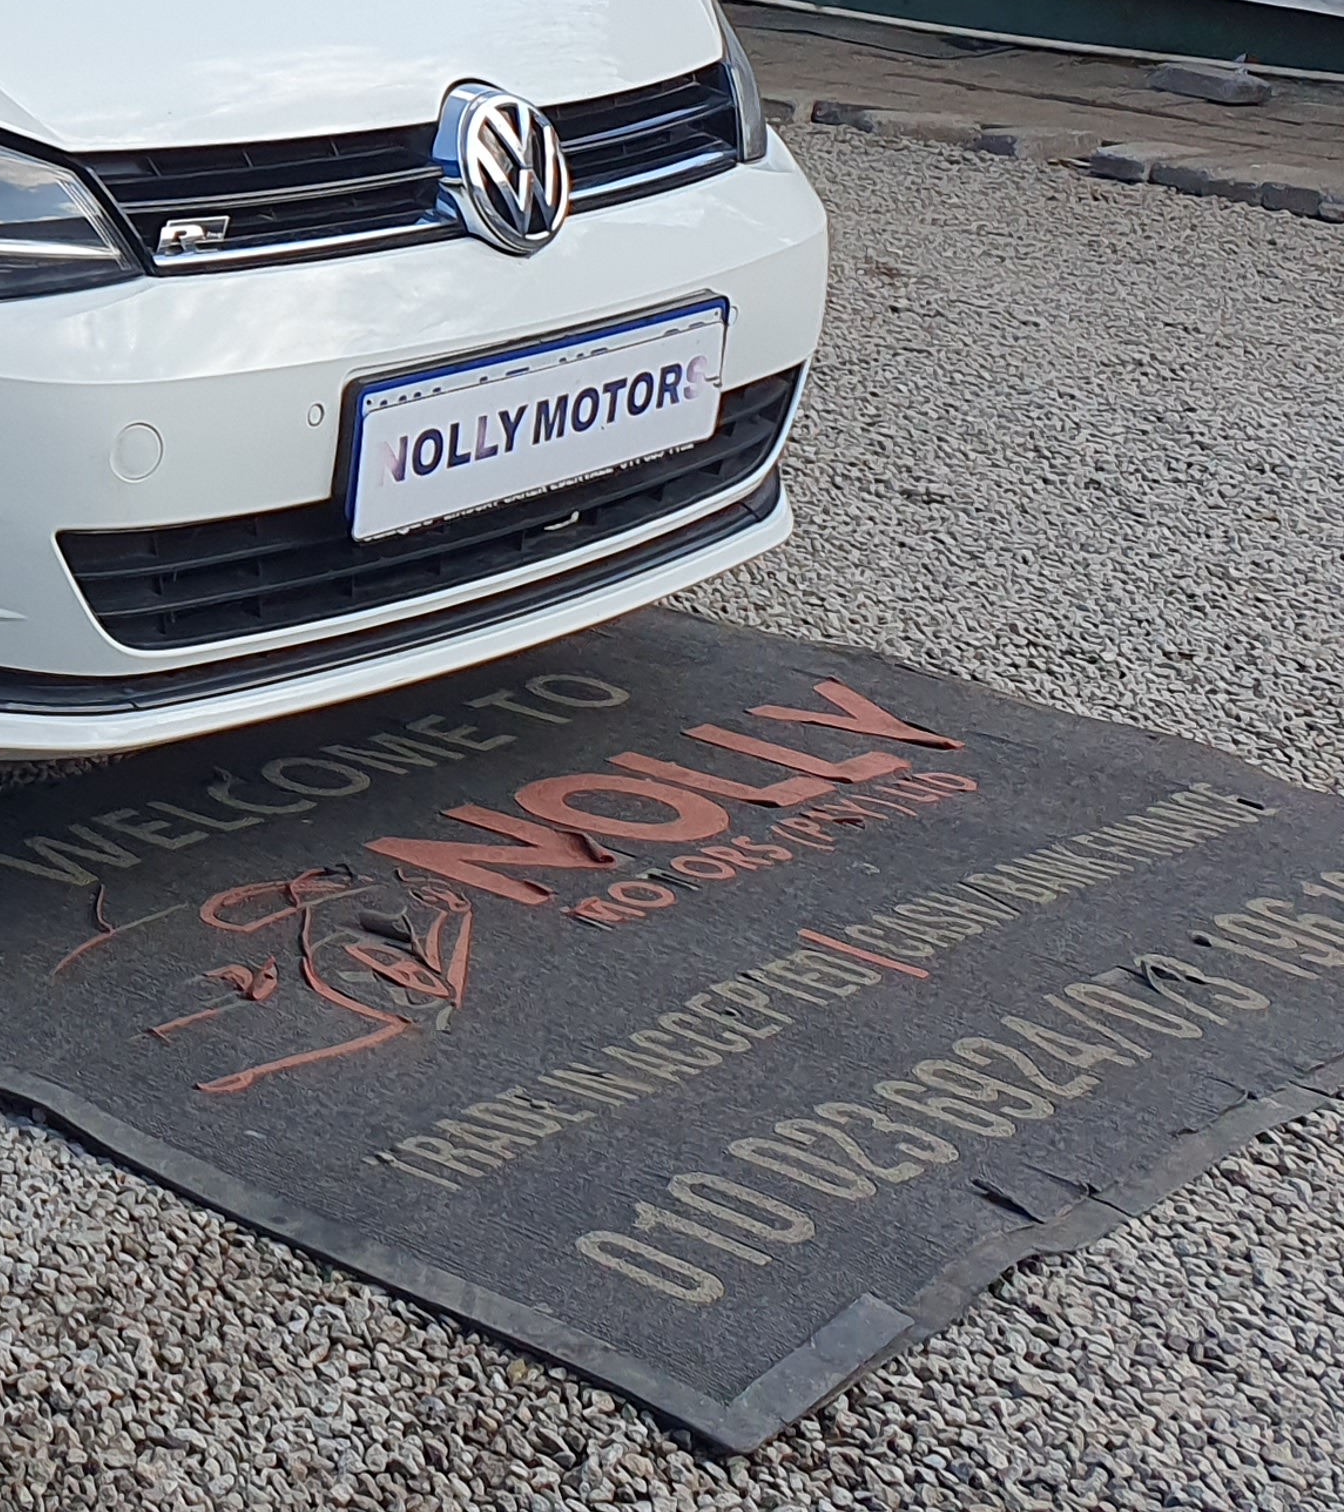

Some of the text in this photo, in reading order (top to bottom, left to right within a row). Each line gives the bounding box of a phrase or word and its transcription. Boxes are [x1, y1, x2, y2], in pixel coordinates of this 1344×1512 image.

[532, 355, 710, 446] MOTORS
[364, 676, 967, 906] NOLLY
[465, 673, 631, 724] TO
[361, 1086, 596, 1191] TRADE
[537, 1061, 640, 1108] IN
[601, 948, 883, 1088] ACCEPTED
[575, 1171, 815, 1306] 010
[728, 1101, 960, 1201] 023
